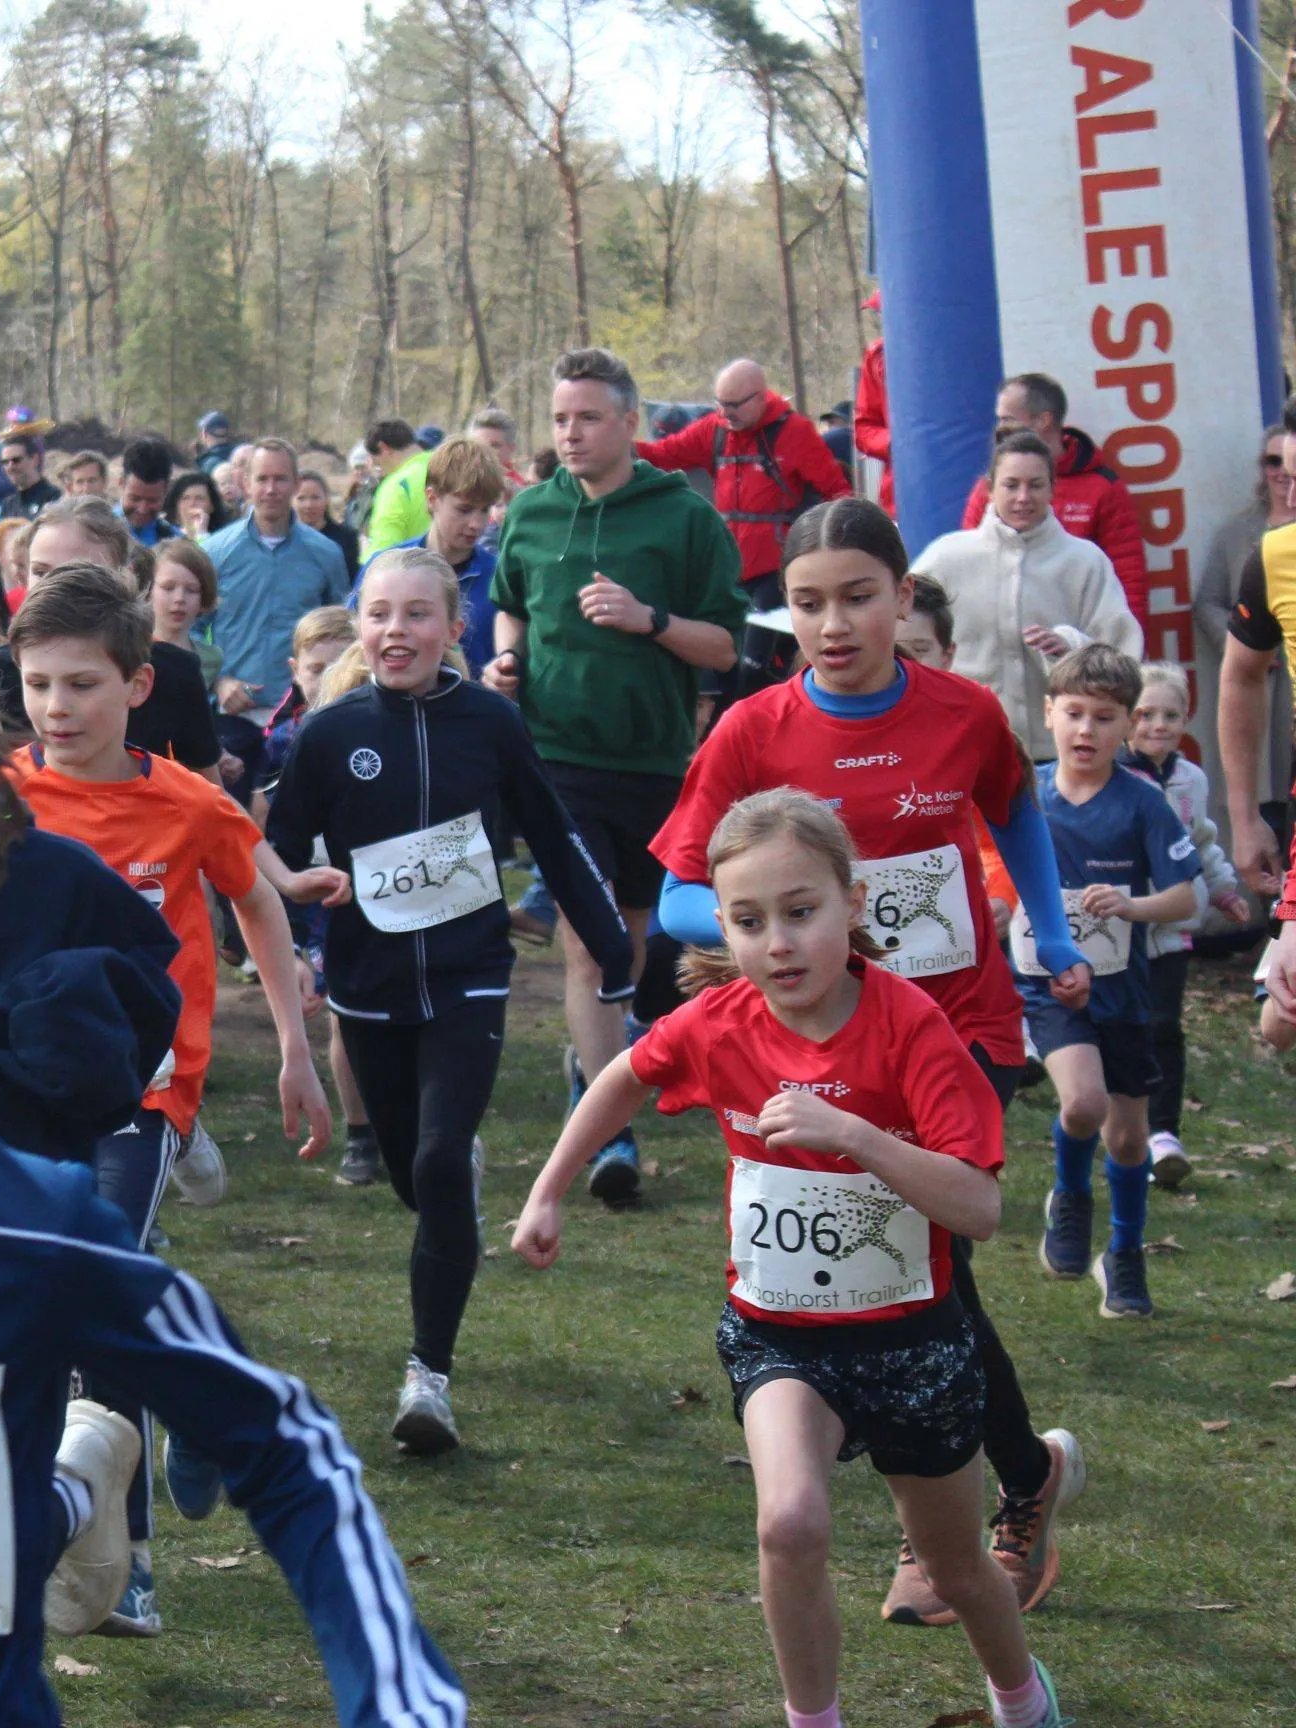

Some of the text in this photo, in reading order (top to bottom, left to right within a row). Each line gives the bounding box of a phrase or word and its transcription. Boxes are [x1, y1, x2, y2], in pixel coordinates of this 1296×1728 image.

[1070, 44, 1168, 285] ALLE
[1089, 302, 1202, 766] SPORTE
[834, 755, 886, 769] CRAFT
[917, 793, 933, 805] De
[128, 861, 168, 877] HOLLAND
[370, 859, 435, 900] 261
[907, 950, 973, 972] Trailrun
[748, 1202, 842, 1256] 206
[847, 1278, 928, 1305] Trailrun
